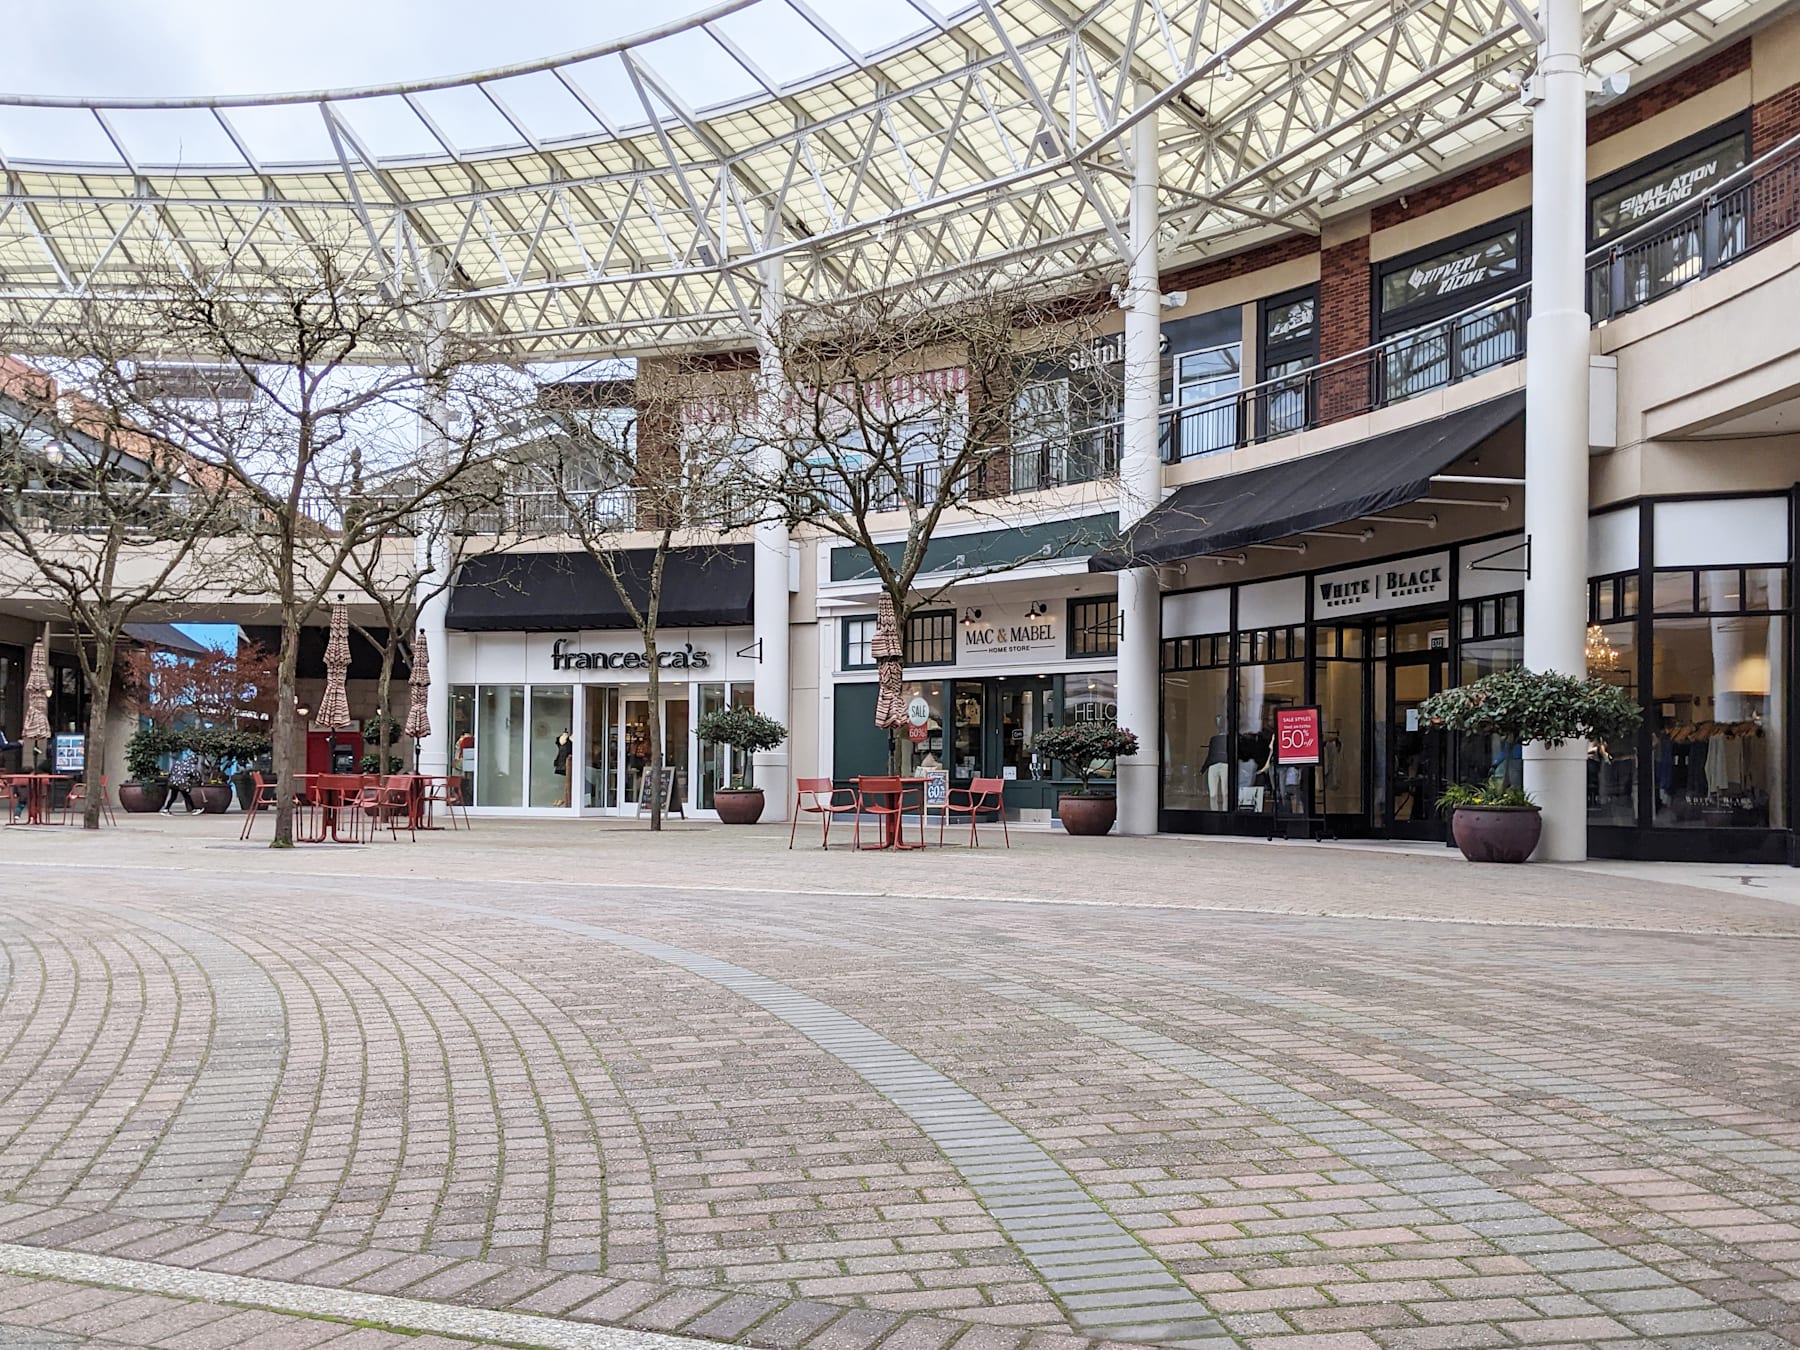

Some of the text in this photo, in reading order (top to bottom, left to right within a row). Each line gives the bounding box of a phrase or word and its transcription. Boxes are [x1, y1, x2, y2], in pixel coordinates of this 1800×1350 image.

[1619, 160, 1718, 214] SIMULATION
[1632, 183, 1693, 219] RACING
[1437, 266, 1487, 295] RACING
[1320, 567, 1442, 600] WHITE BLACK
[966, 624, 1056, 645] MAC & MABEL
[911, 705, 926, 718] SALE
[1074, 702, 1118, 720] HELLO
